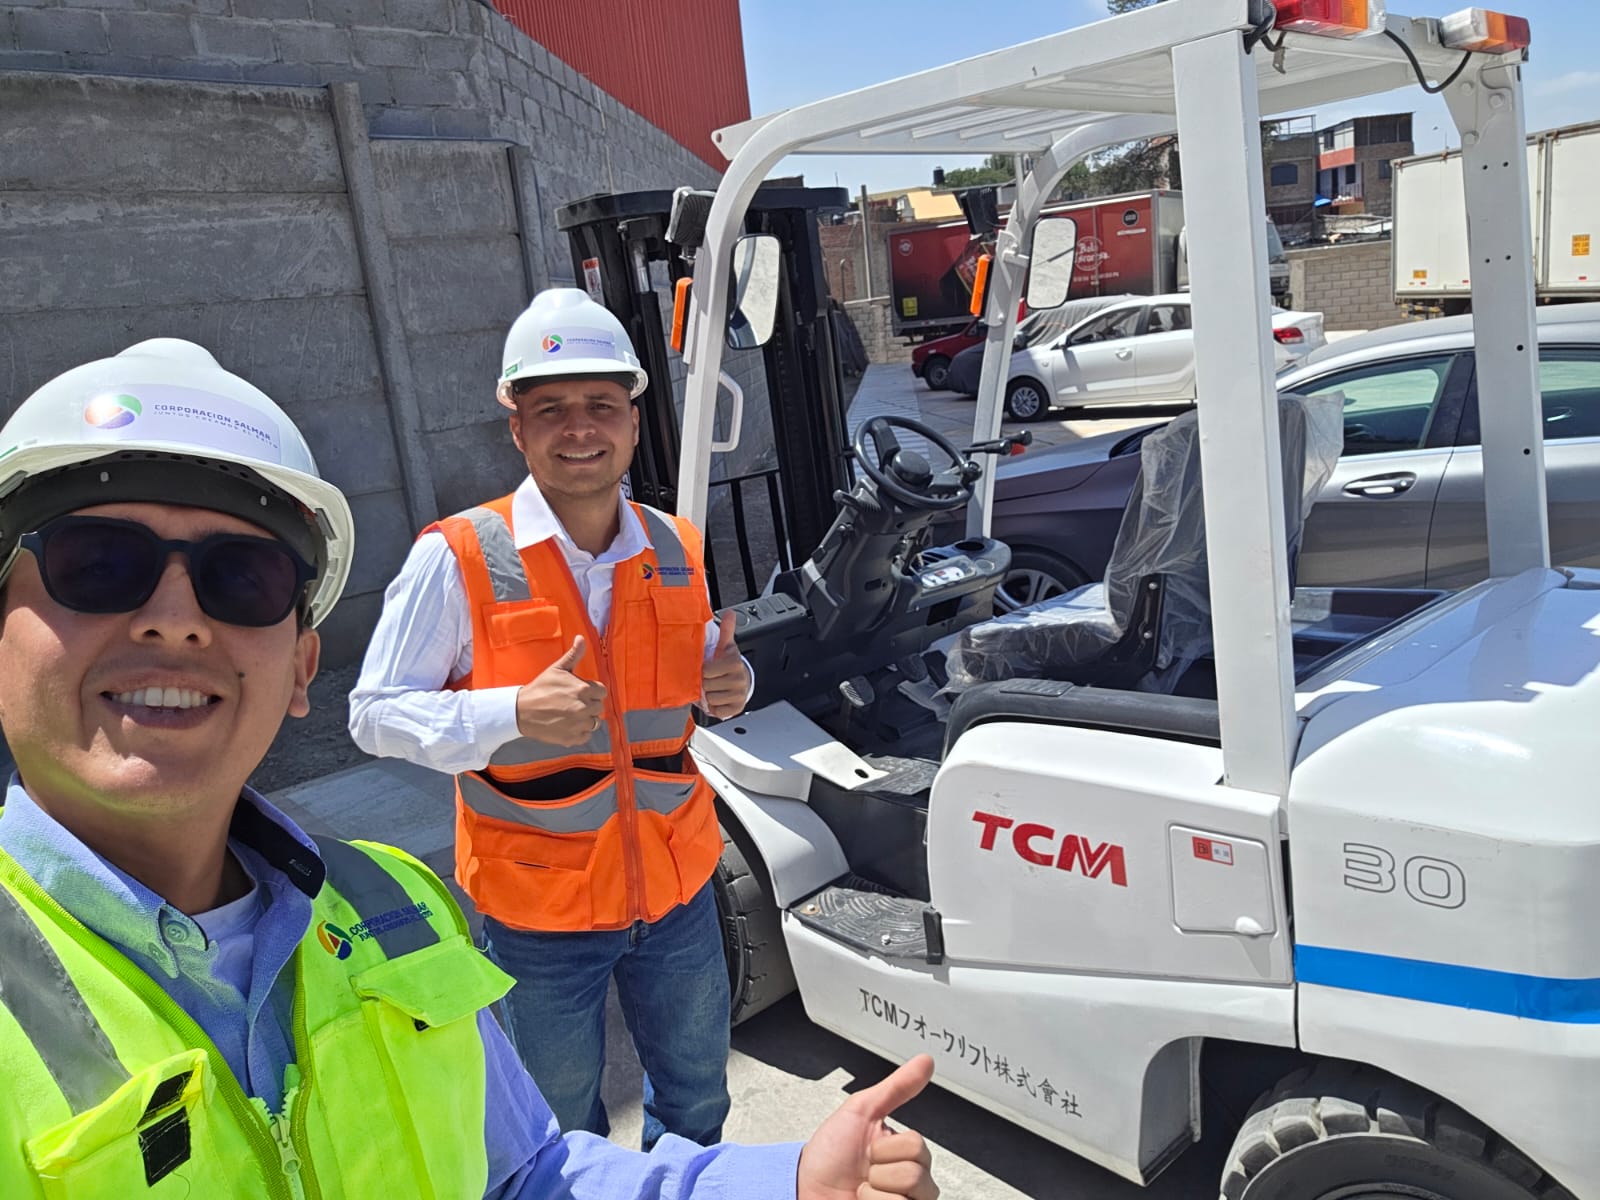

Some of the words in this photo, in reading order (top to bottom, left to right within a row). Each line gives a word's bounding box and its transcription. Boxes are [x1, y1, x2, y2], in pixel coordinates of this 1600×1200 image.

[154, 403, 231, 423] CORPORACION
[234, 420, 271, 441] SALMAR
[972, 810, 1128, 888] TCM
[1343, 842, 1466, 909] 30
